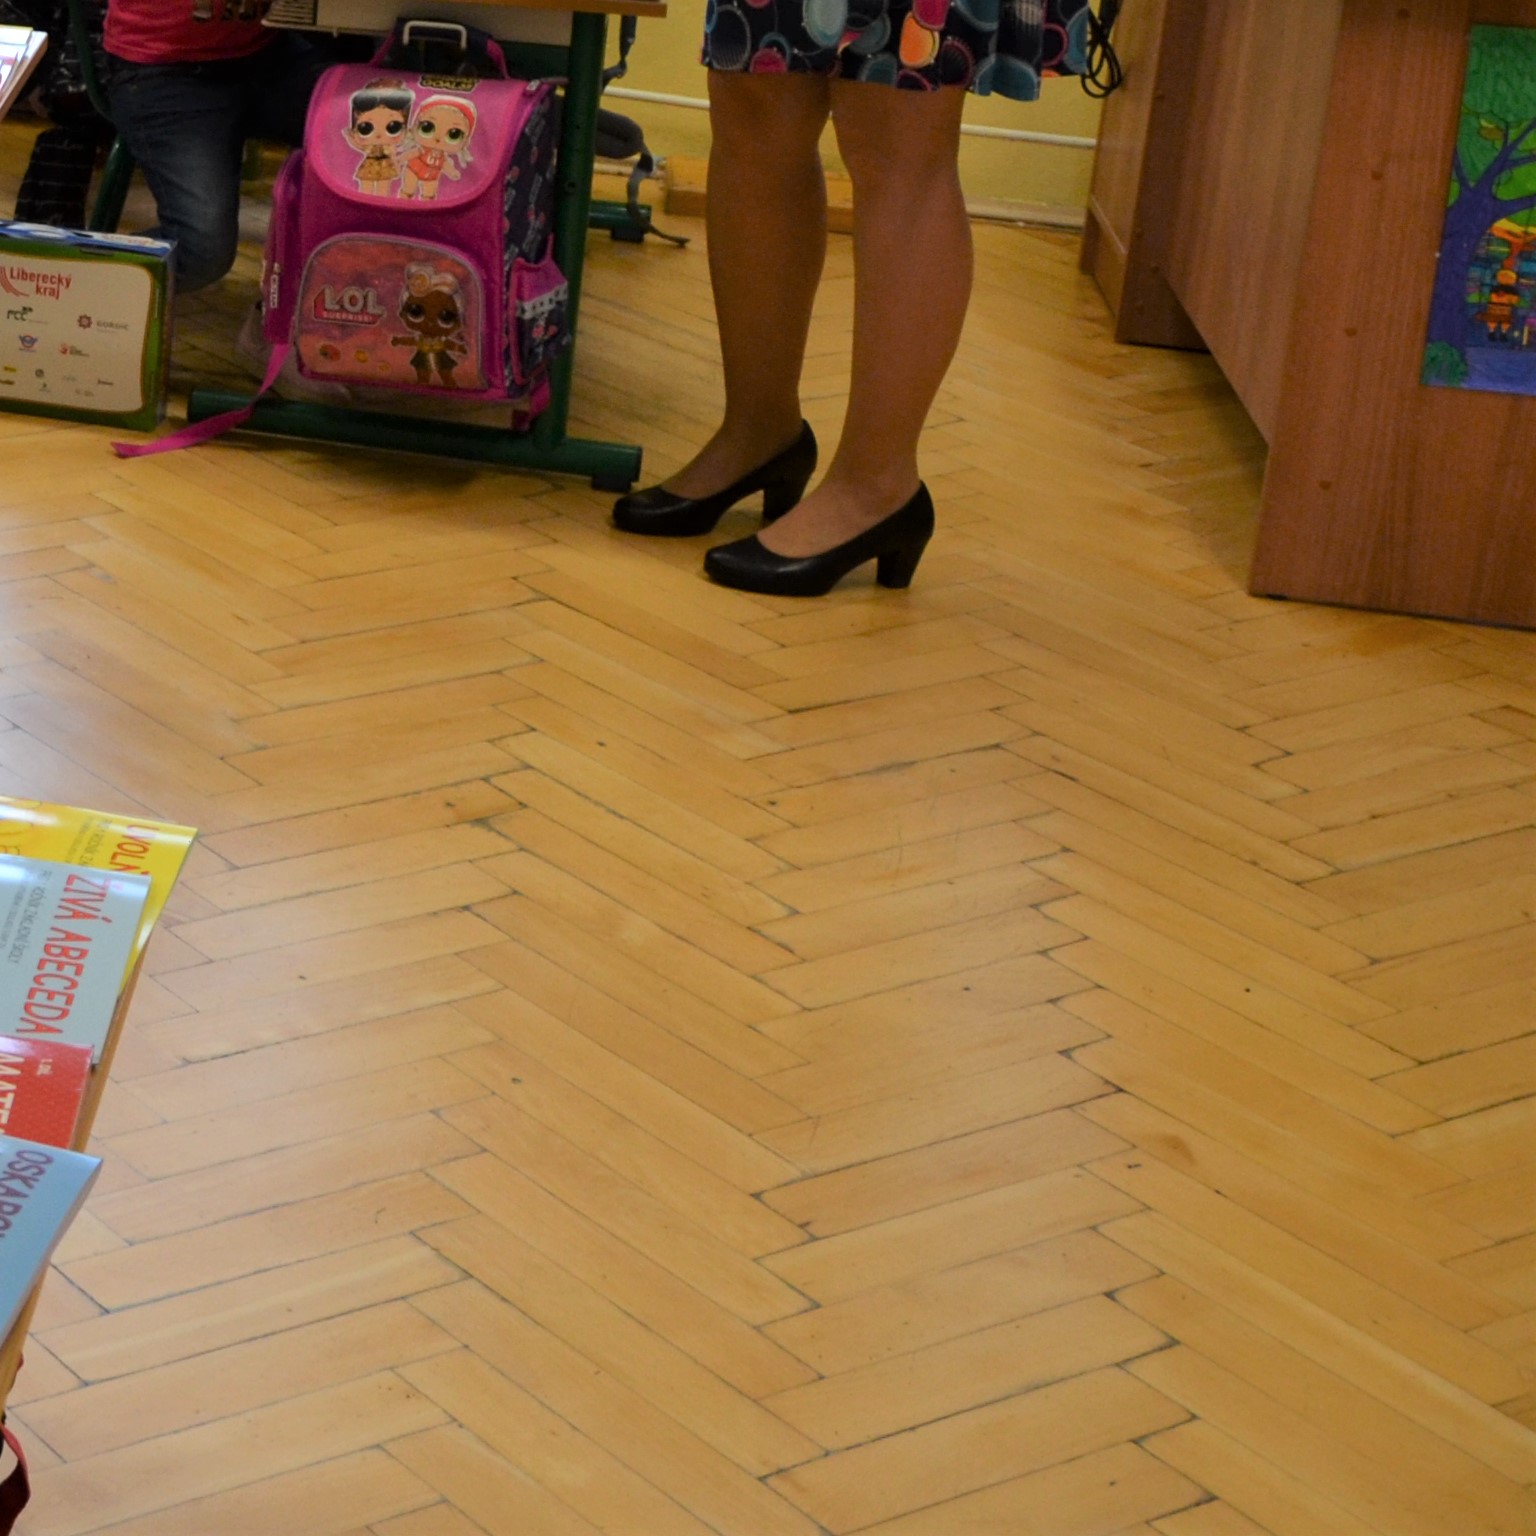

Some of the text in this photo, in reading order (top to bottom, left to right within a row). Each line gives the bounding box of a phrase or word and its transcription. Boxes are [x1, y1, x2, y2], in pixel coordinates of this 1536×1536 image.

[10, 267, 72, 289] Liberecký
[36, 279, 60, 300] kraj
[16, 926, 93, 1034] ABECEDA
